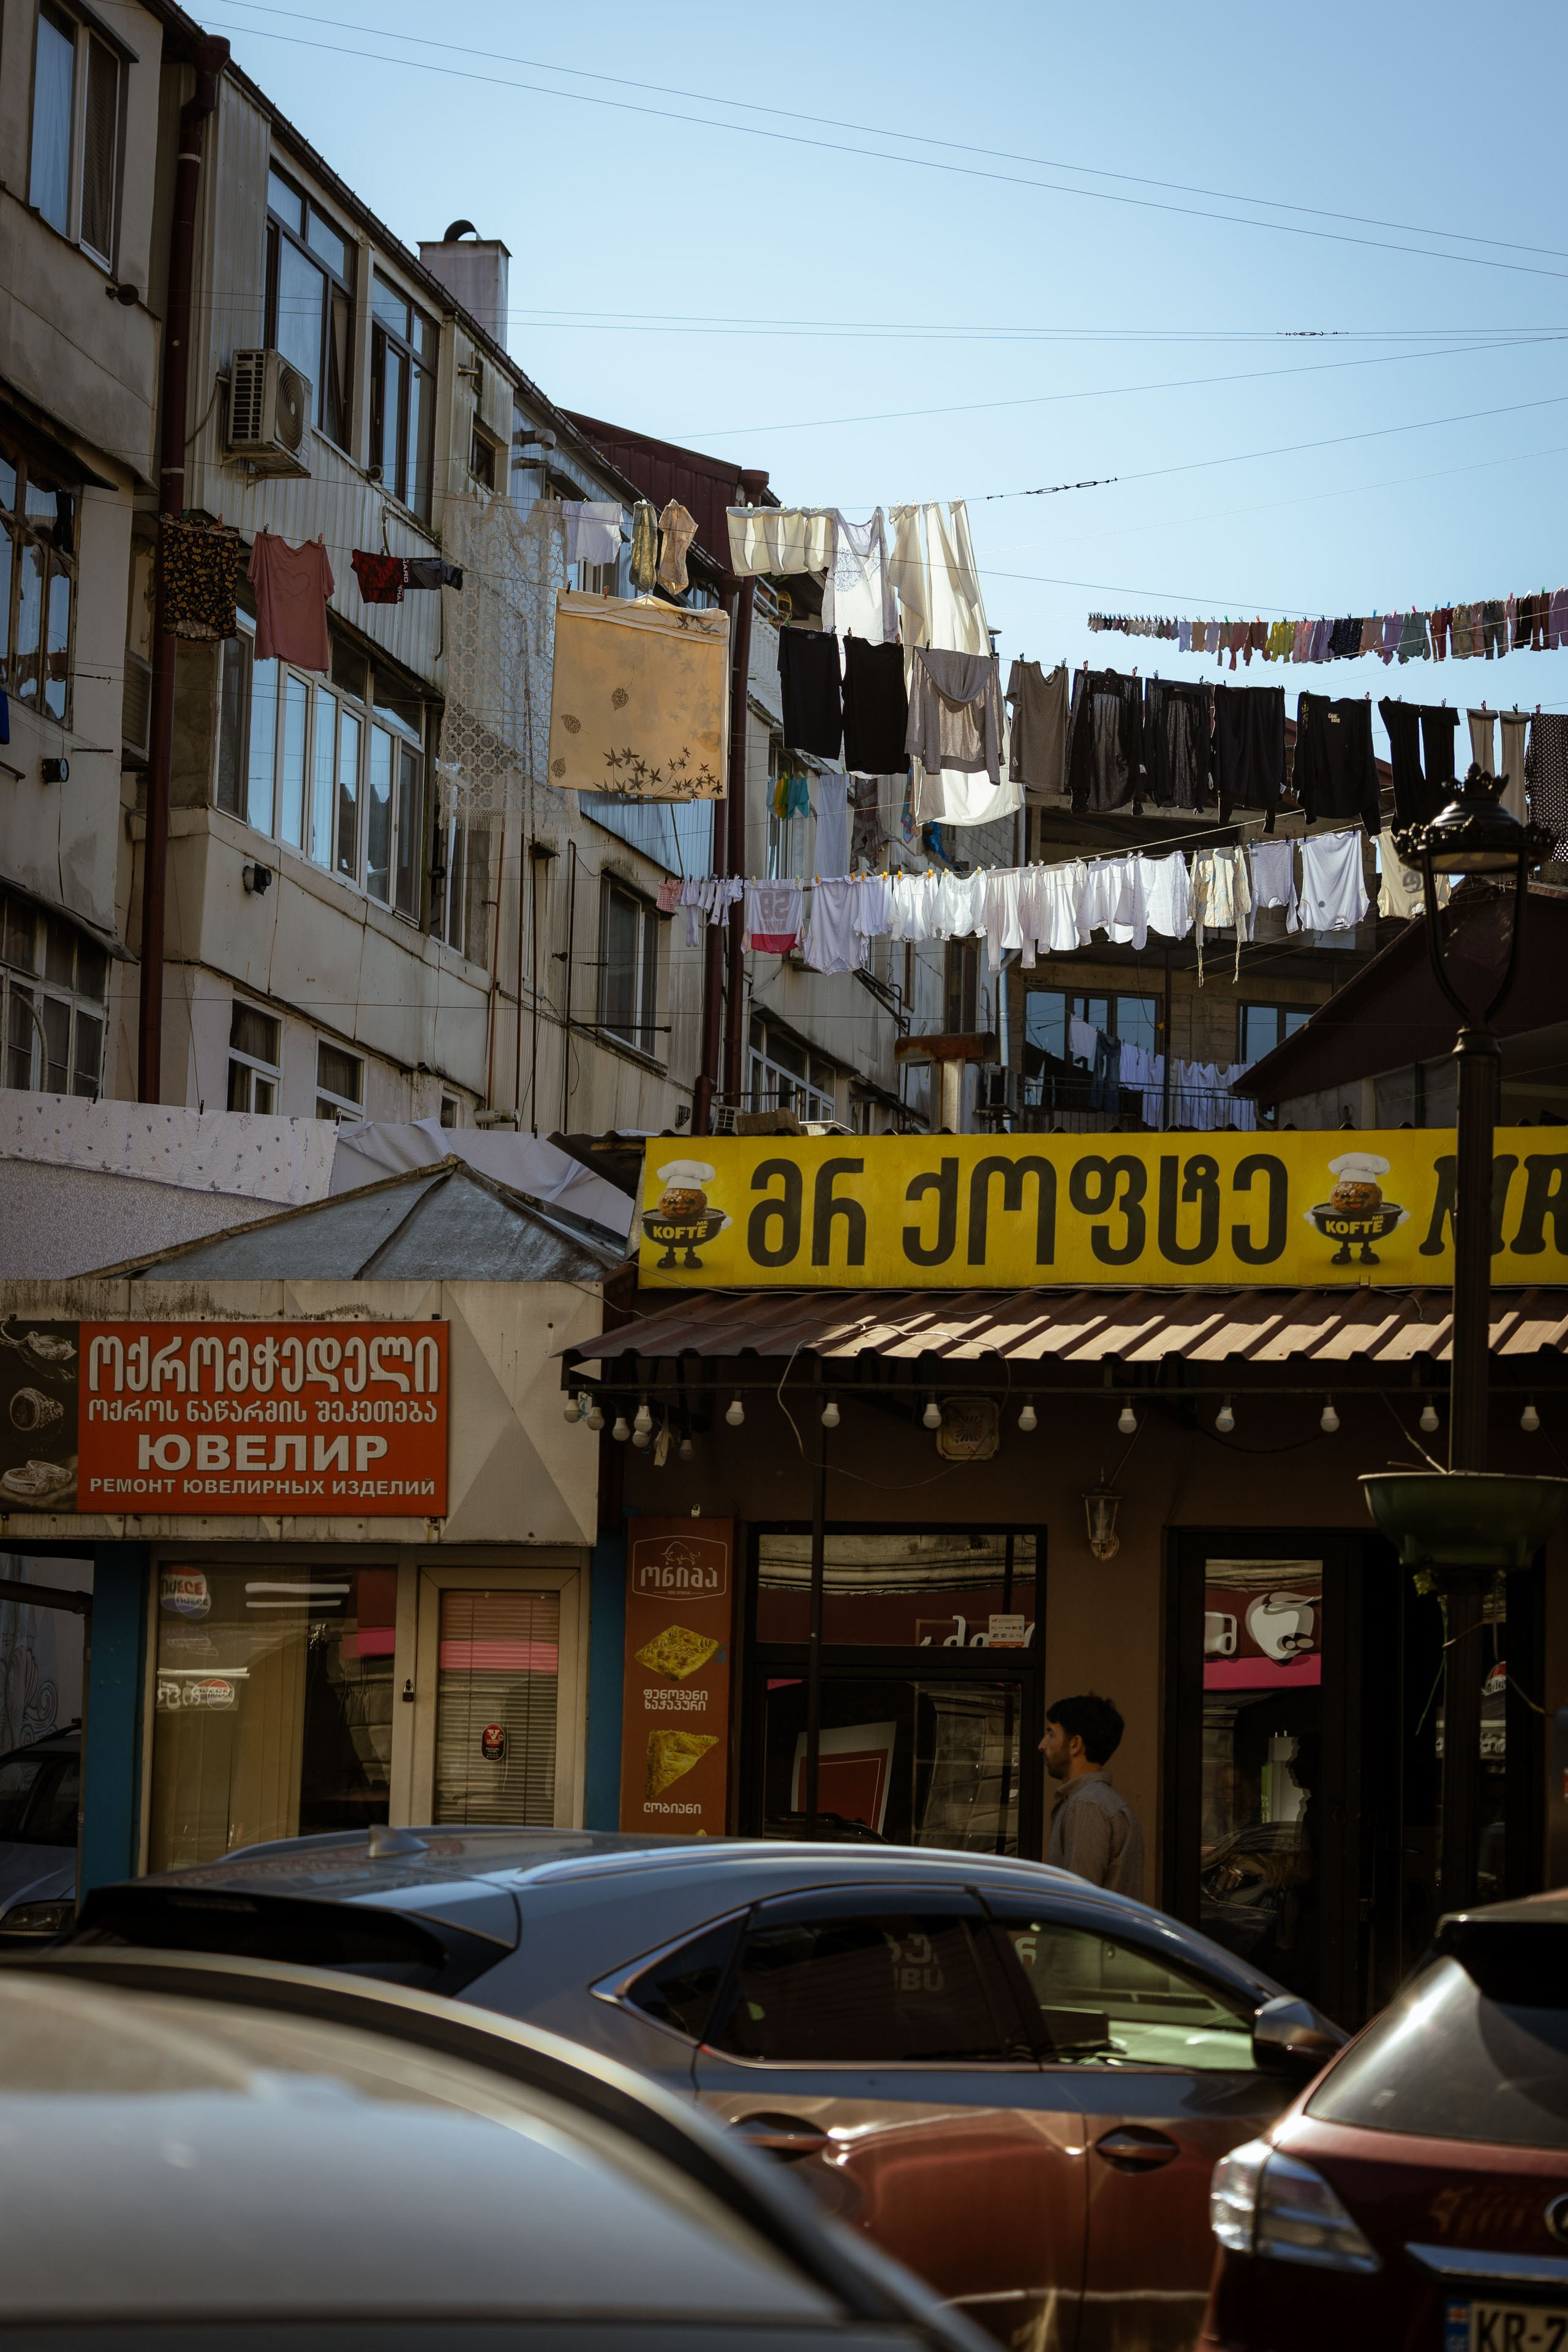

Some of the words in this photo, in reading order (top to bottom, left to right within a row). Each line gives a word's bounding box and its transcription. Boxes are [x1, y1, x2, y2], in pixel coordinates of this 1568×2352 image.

[747, 1158, 866, 1267] მრ
[902, 1154, 1288, 1267] ქოფტე
[653, 1225, 707, 1239] KOFTE
[1325, 1220, 1384, 1235] KOFTE
[89, 1335, 439, 1393] ოქრომჭედელი
[88, 1399, 179, 1422] ოქროს
[186, 1400, 306, 1423] ნაწარმის
[316, 1400, 438, 1423] შეკეთება
[138, 1434, 388, 1471] ЮВЕЛИР
[89, 1478, 176, 1493] РЕМОНТ
[184, 1479, 325, 1494] ЮВЕЛИРНЫХ
[332, 1477, 435, 1497] ИЗДЕЛИЙ
[640, 1566, 718, 1588] ონიმა
[643, 1689, 708, 1701] ფენოვანი
[644, 1700, 706, 1711] ხაჭაპური
[643, 1802, 701, 1814] ლობიანი
